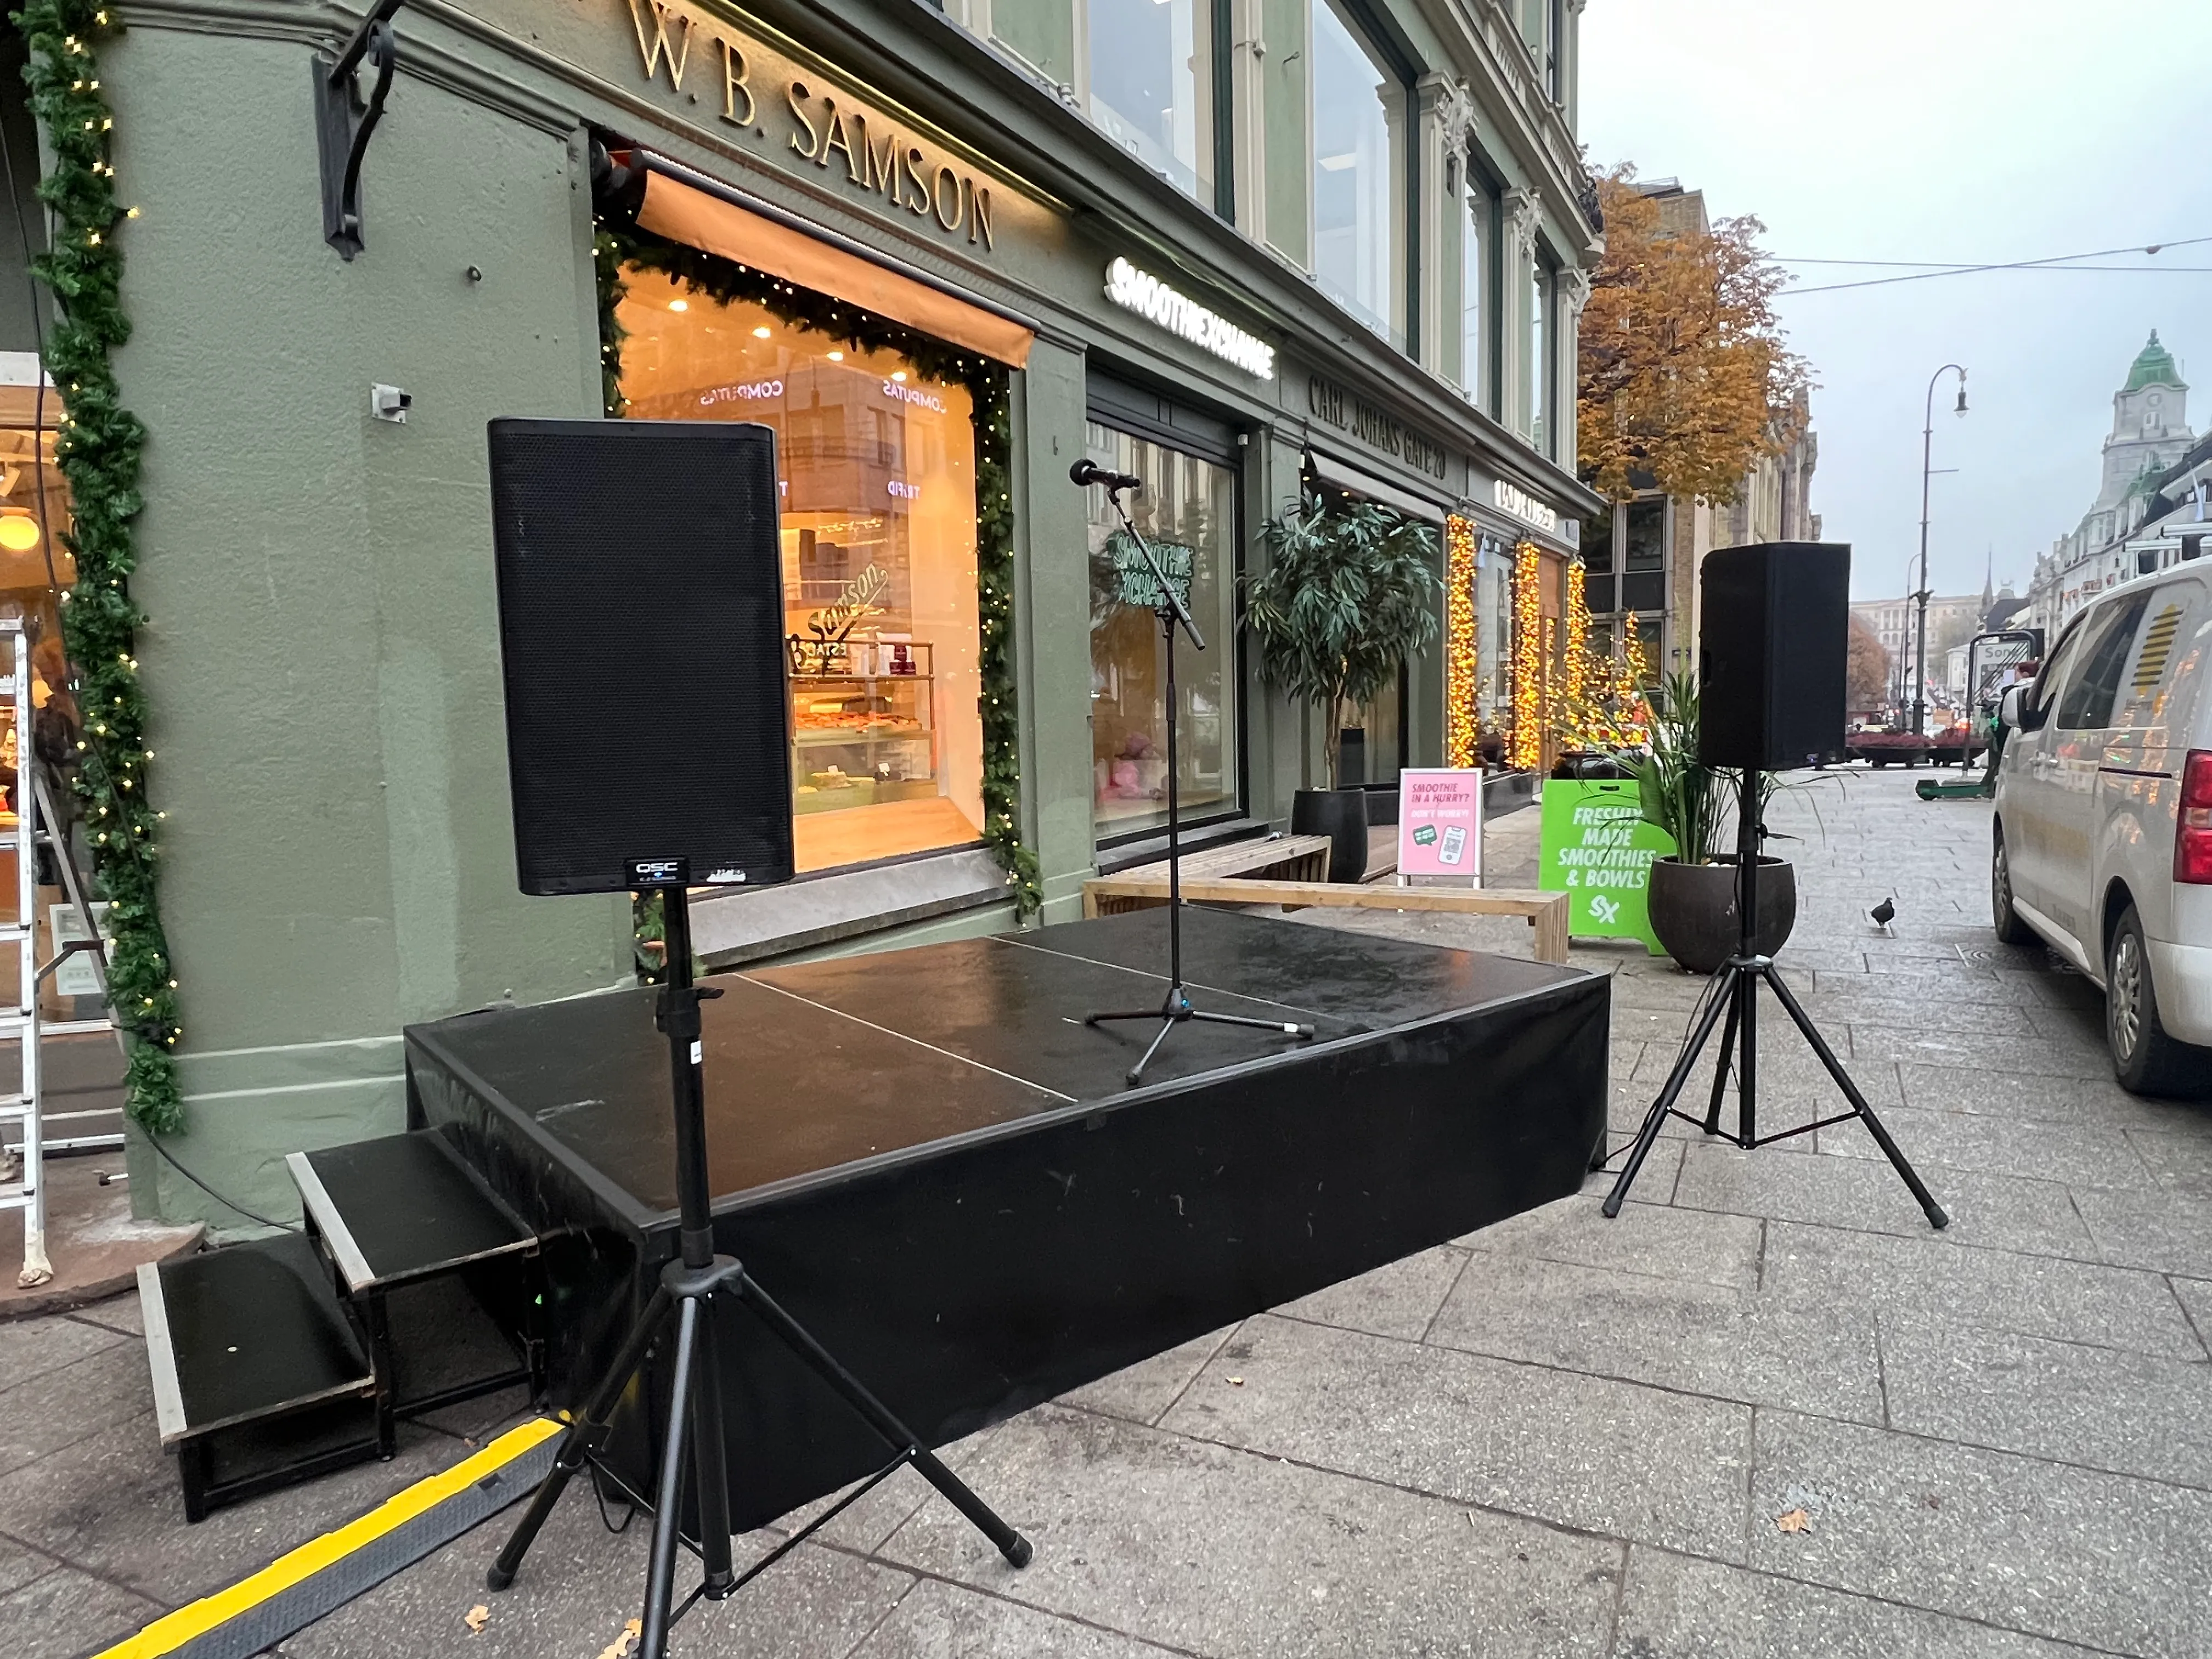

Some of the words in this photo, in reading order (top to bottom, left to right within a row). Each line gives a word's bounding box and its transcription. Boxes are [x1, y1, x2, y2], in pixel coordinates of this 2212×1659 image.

[715, 36, 769, 137] B.
[787, 82, 993, 251] SAMSON
[1308, 375, 1348, 431] CARL
[1352, 399, 1400, 456] JOHANS
[1404, 430, 1432, 473] GATE
[808, 563, 883, 642] Samson
[1412, 783, 1458, 792] SMOOTHIE
[1411, 794, 1421, 803] IN
[1432, 793, 1470, 803] HURRY?
[1573, 808, 1644, 825] FRESHLY
[1582, 828, 1634, 847] MADE
[636, 862, 678, 873] QSC
[1558, 848, 1656, 868] SMOOTHIES
[1566, 869, 1579, 887] &
[1585, 869, 1646, 889] BOWLS
